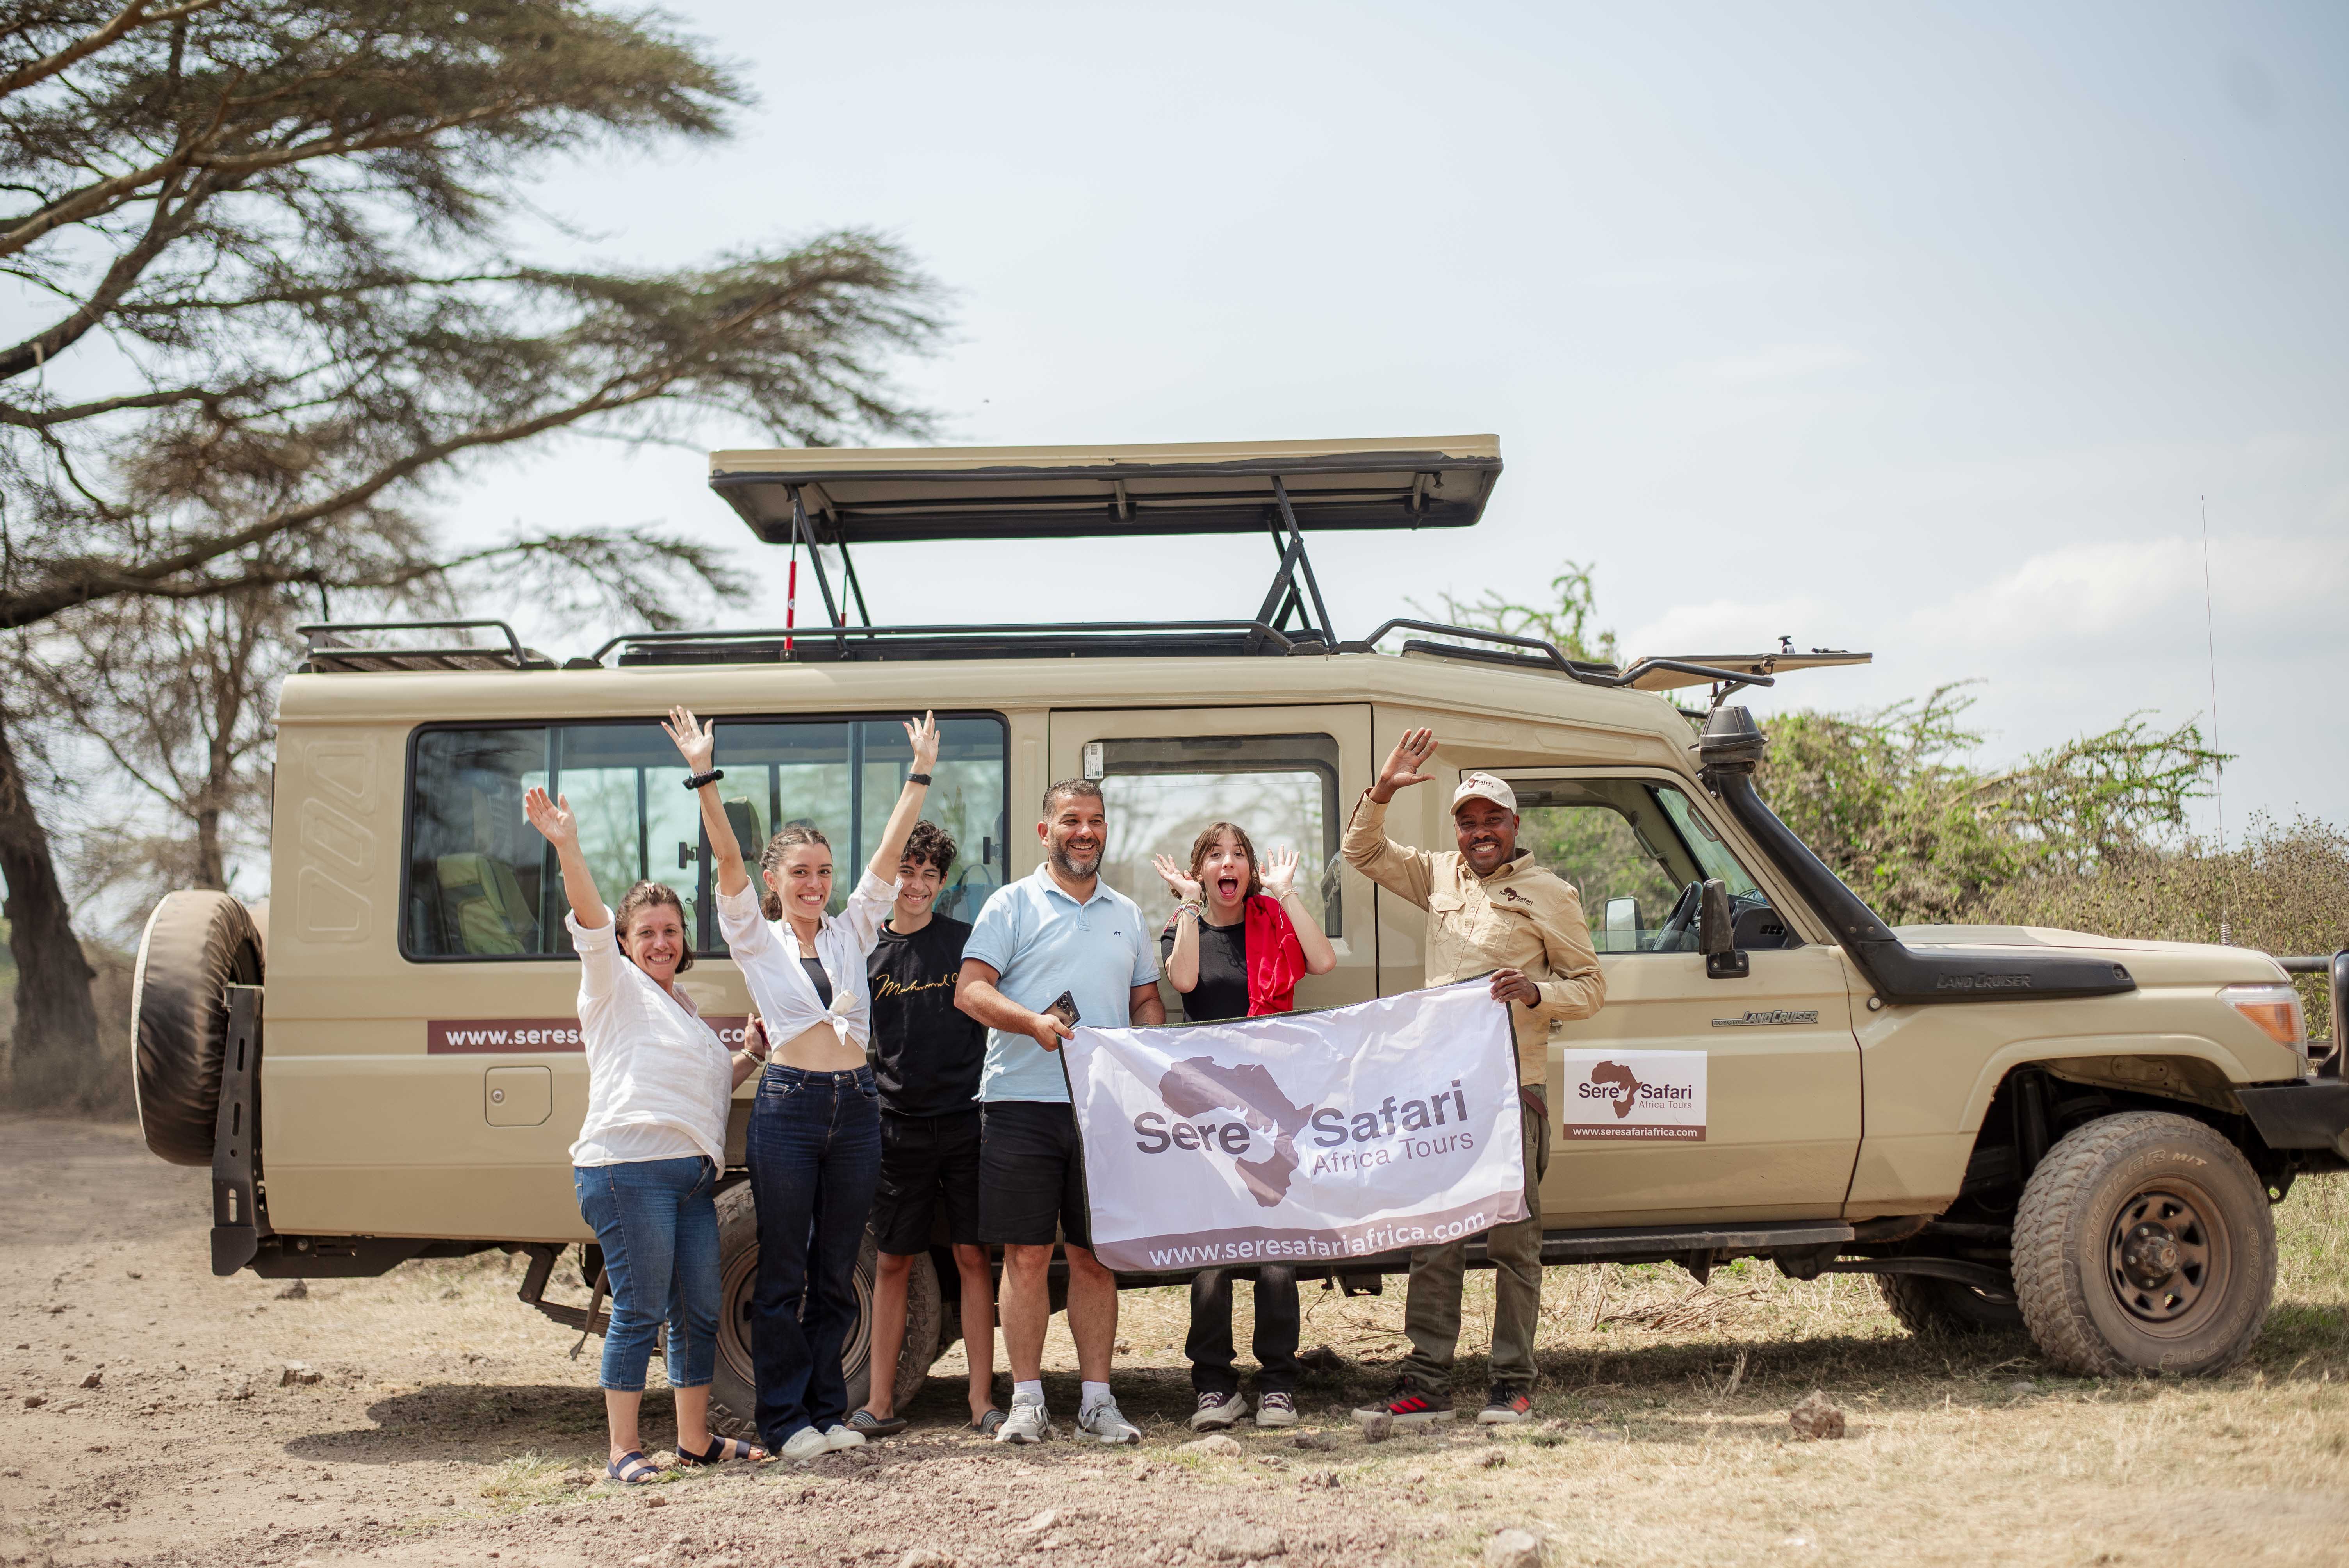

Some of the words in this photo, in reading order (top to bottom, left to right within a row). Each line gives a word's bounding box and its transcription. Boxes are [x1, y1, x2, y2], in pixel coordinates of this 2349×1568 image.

[1517, 896, 1533, 905] Safari
[1579, 1083, 1620, 1098] Sere
[1641, 1083, 1691, 1099] Safari
[1639, 1100, 1665, 1108] Africa
[1668, 1101, 1692, 1109] Tours
[1134, 1112, 1250, 1155] Sere
[1311, 1079, 1468, 1147] Safari
[1573, 1127, 1697, 1137] www.seresafariafrica.com
[1313, 1149, 1392, 1175] Africa
[1398, 1132, 1474, 1159] Tours
[2171, 1153, 2208, 1166] M/T
[1149, 1211, 1485, 1266] www.seresafariafrica.com
[2160, 1226, 2260, 1365] BRIDGESTONE
